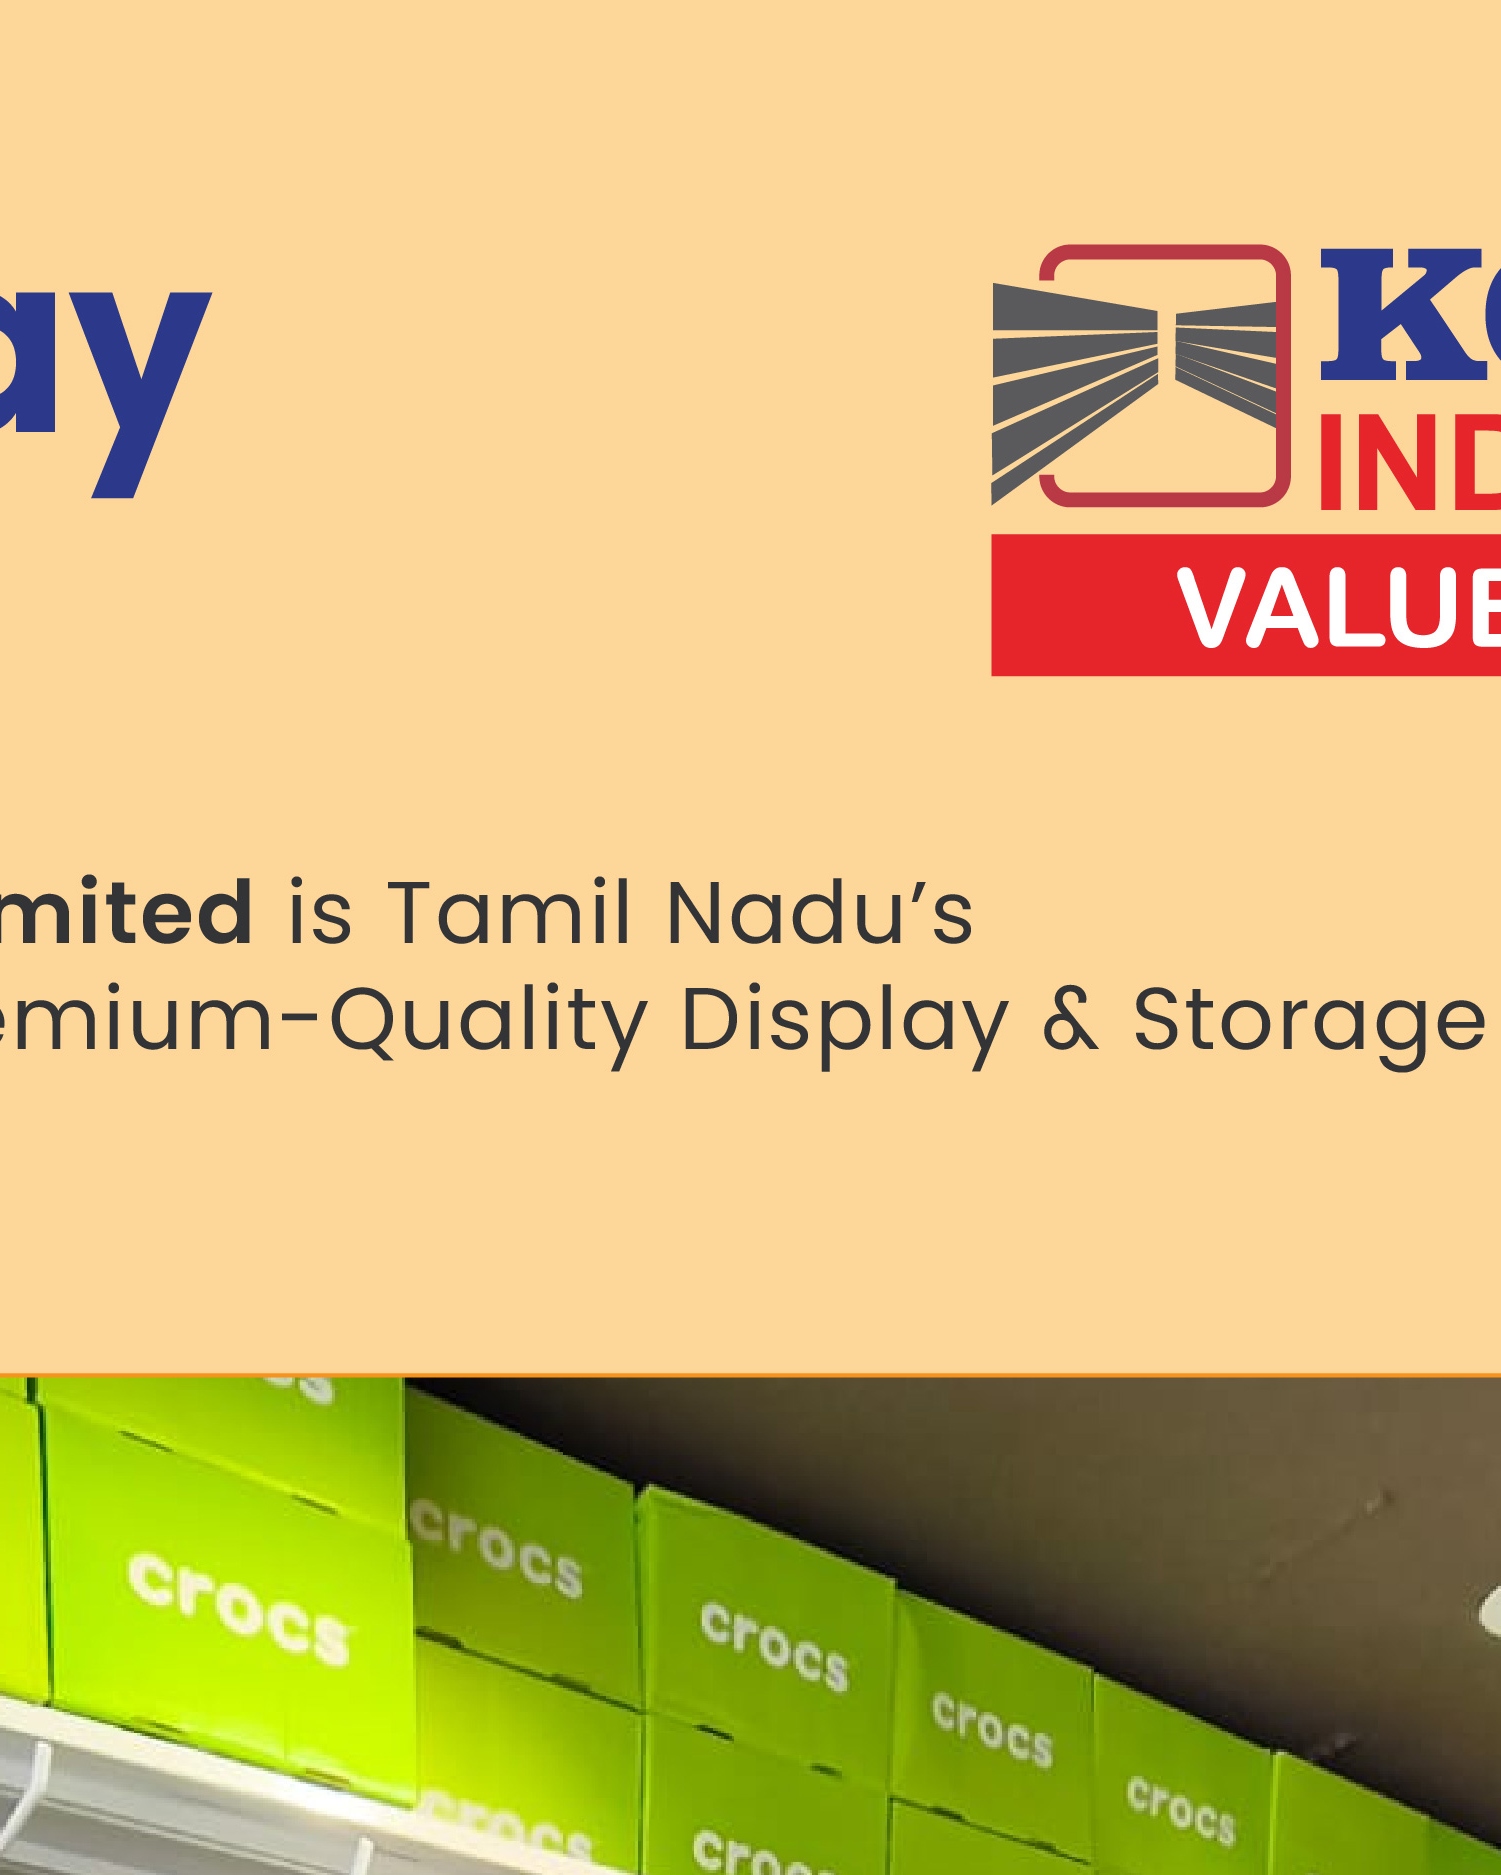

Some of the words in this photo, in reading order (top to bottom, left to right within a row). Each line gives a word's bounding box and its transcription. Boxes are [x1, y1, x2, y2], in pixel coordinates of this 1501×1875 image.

[409, 1498, 584, 1601] crocs
[126, 1551, 352, 1668] crocs
[700, 1601, 850, 1693] crocs
[931, 1691, 1055, 1769] crocs
[1126, 1774, 1238, 1848] crocs
